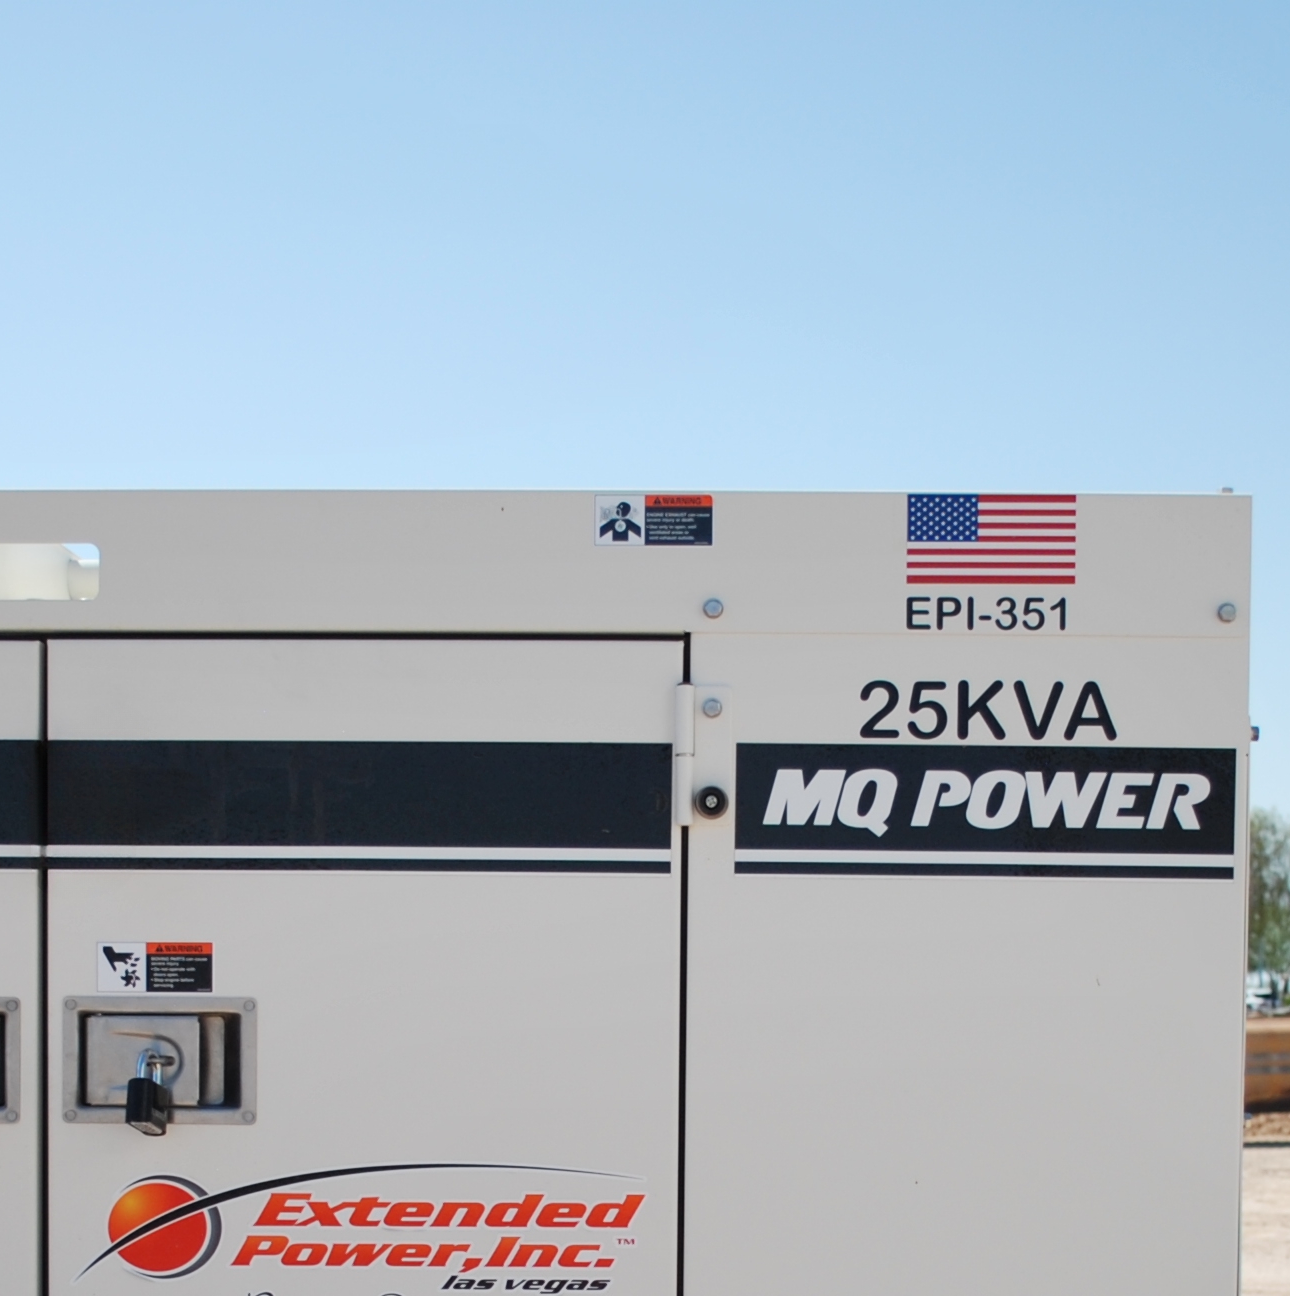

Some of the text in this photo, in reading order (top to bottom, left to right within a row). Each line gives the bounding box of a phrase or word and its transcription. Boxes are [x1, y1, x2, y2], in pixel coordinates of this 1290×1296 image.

[662, 497, 702, 505] WARNING
[905, 596, 1068, 632] EPI-351
[858, 679, 1119, 742] 25KVA
[762, 768, 1212, 837] MQ POWER
[253, 1192, 646, 1229] Extended
[440, 1274, 610, 1294] las vegas
